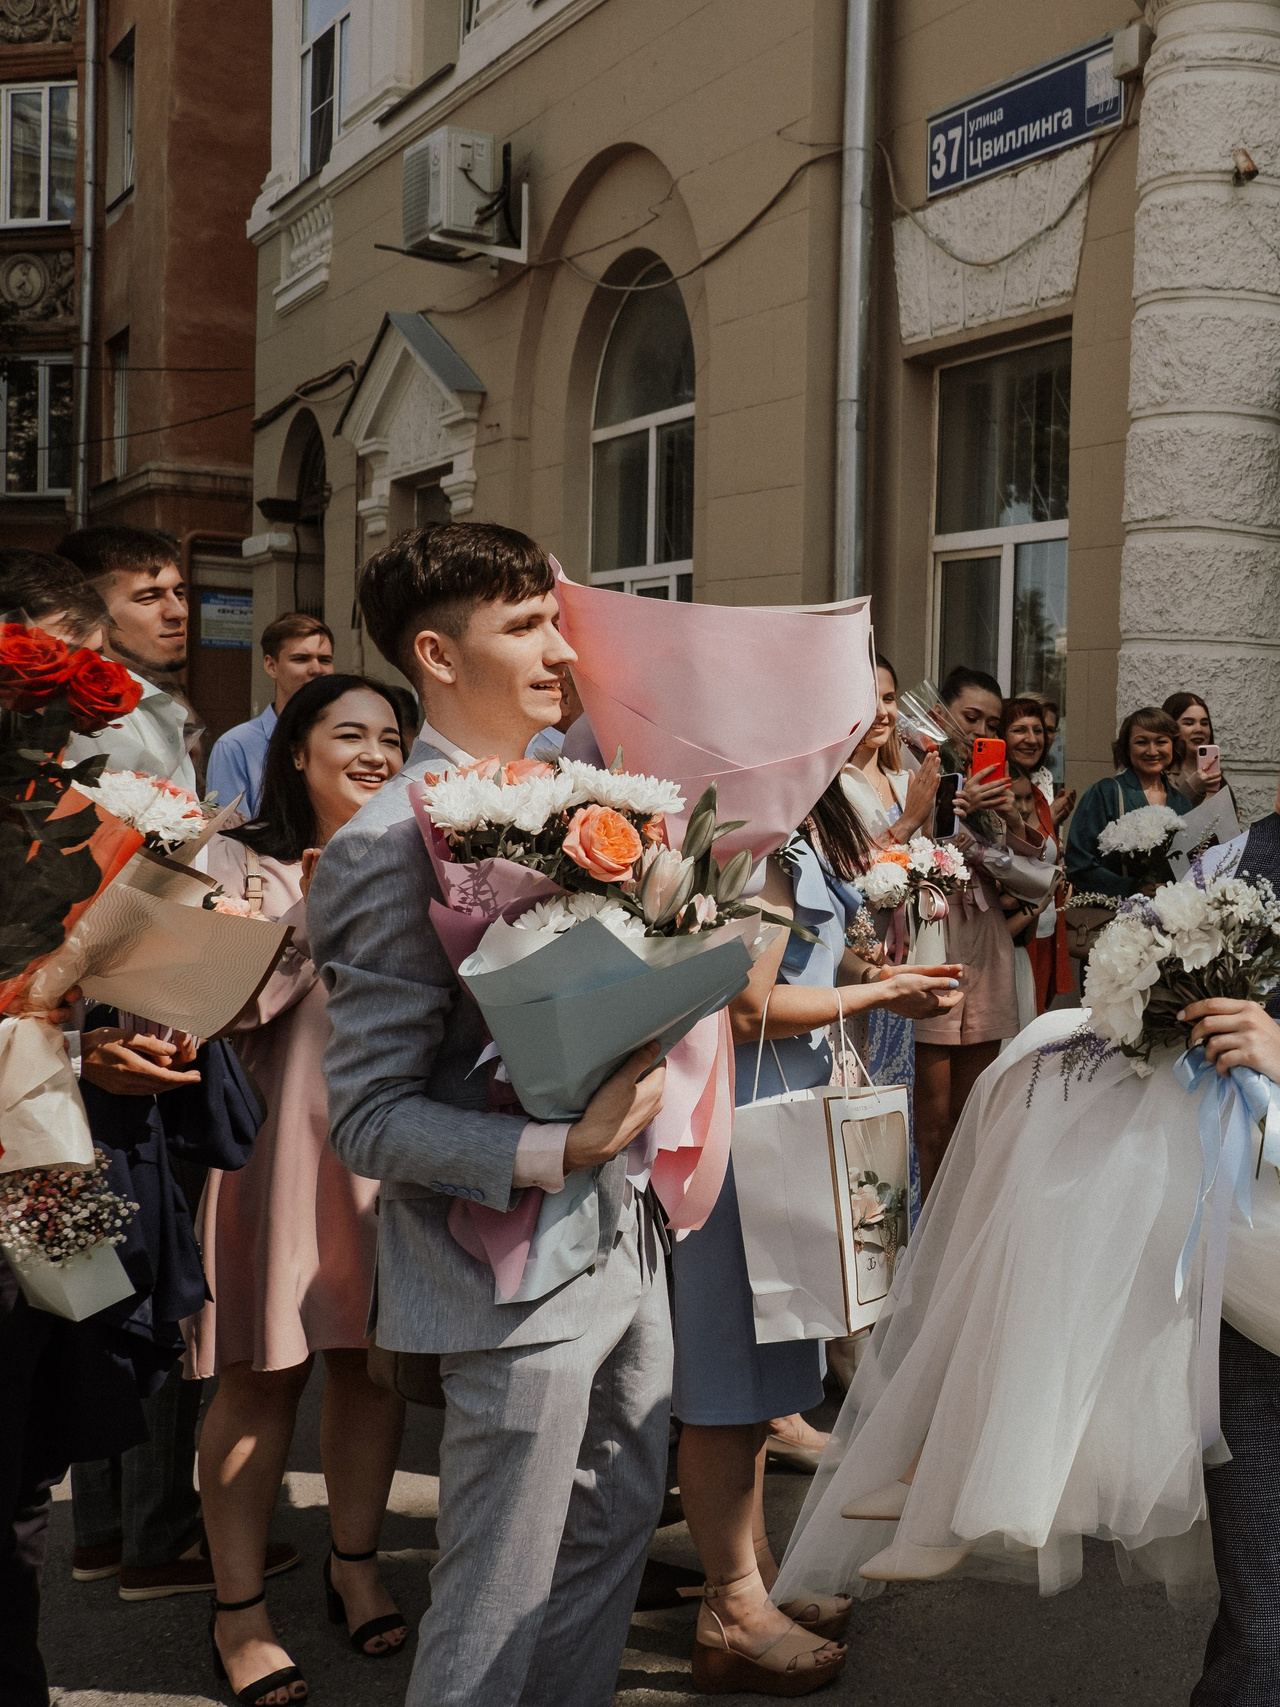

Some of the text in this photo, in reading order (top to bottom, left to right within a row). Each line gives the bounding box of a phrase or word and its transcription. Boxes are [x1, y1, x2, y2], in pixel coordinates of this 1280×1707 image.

[968, 107, 1004, 138] улица
[969, 107, 1073, 168] Цвиллинга
[931, 126, 962, 180] 37
